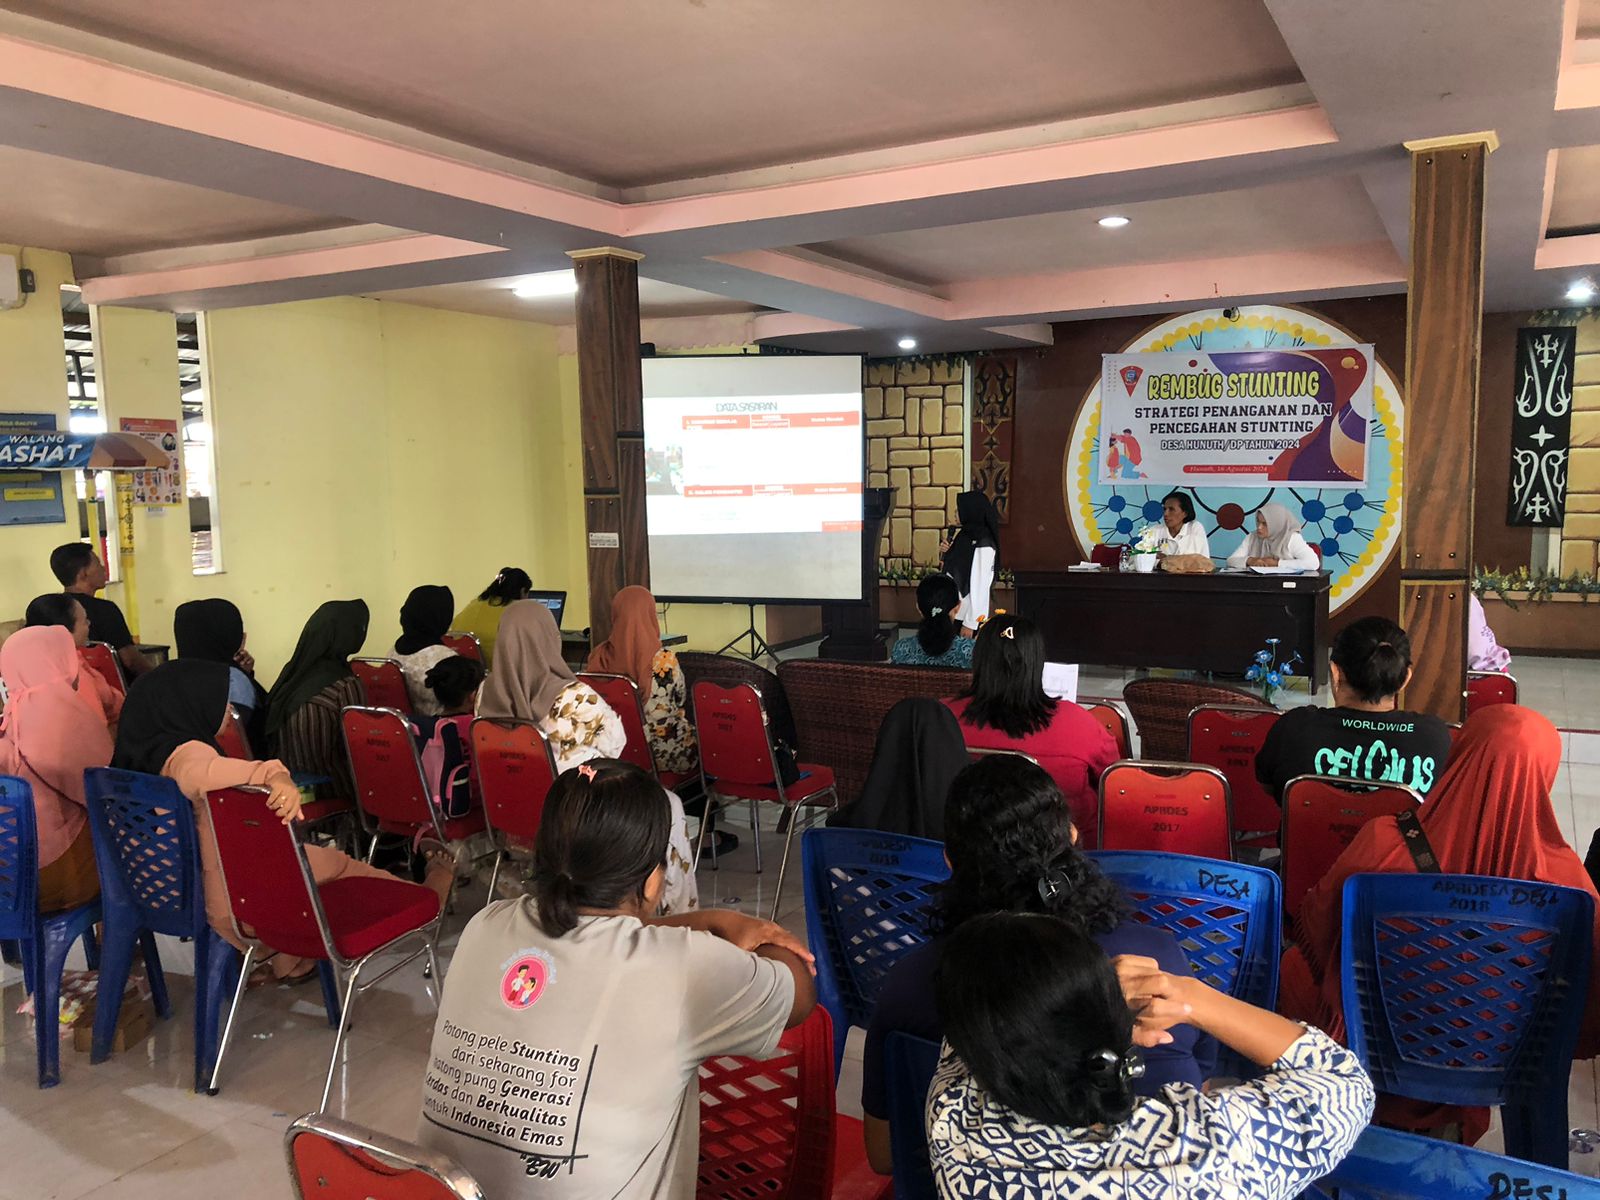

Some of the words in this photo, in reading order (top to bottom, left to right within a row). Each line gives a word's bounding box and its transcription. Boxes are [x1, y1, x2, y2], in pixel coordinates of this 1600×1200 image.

[1148, 373, 1223, 400] REMBUG
[1227, 371, 1320, 398] STUNTING
[1134, 406, 1199, 419] STRATEGI
[1202, 404, 1298, 418] PENANGANAN
[1301, 402, 1331, 416] DAN
[9, 434, 65, 443] WALANG
[1149, 421, 1237, 435] PENCEGAHAN
[1240, 420, 1313, 433] STUNTING
[1161, 440, 1185, 450] DESA
[1243, 440, 1275, 450] TAHUN
[1276, 439, 1300, 449] 2024
[1342, 718, 1414, 732] WORLDWIDE
[1152, 821, 1181, 832] 2017
[1198, 868, 1250, 900] DESA
[1449, 896, 1491, 912] 2018
[442, 1019, 476, 1047] Potong
[478, 1032, 508, 1052] pele
[510, 1041, 581, 1072] Stunting
[452, 1046, 477, 1065] dari
[478, 1053, 545, 1087] sekarang
[549, 1070, 577, 1088] for
[463, 1069, 498, 1094] pung
[501, 1080, 574, 1107] Generasi
[450, 1087, 474, 1105] dan
[476, 1094, 568, 1127] Berkualitas
[450, 1106, 516, 1138] Indonesia
[519, 1127, 564, 1147] Emas
